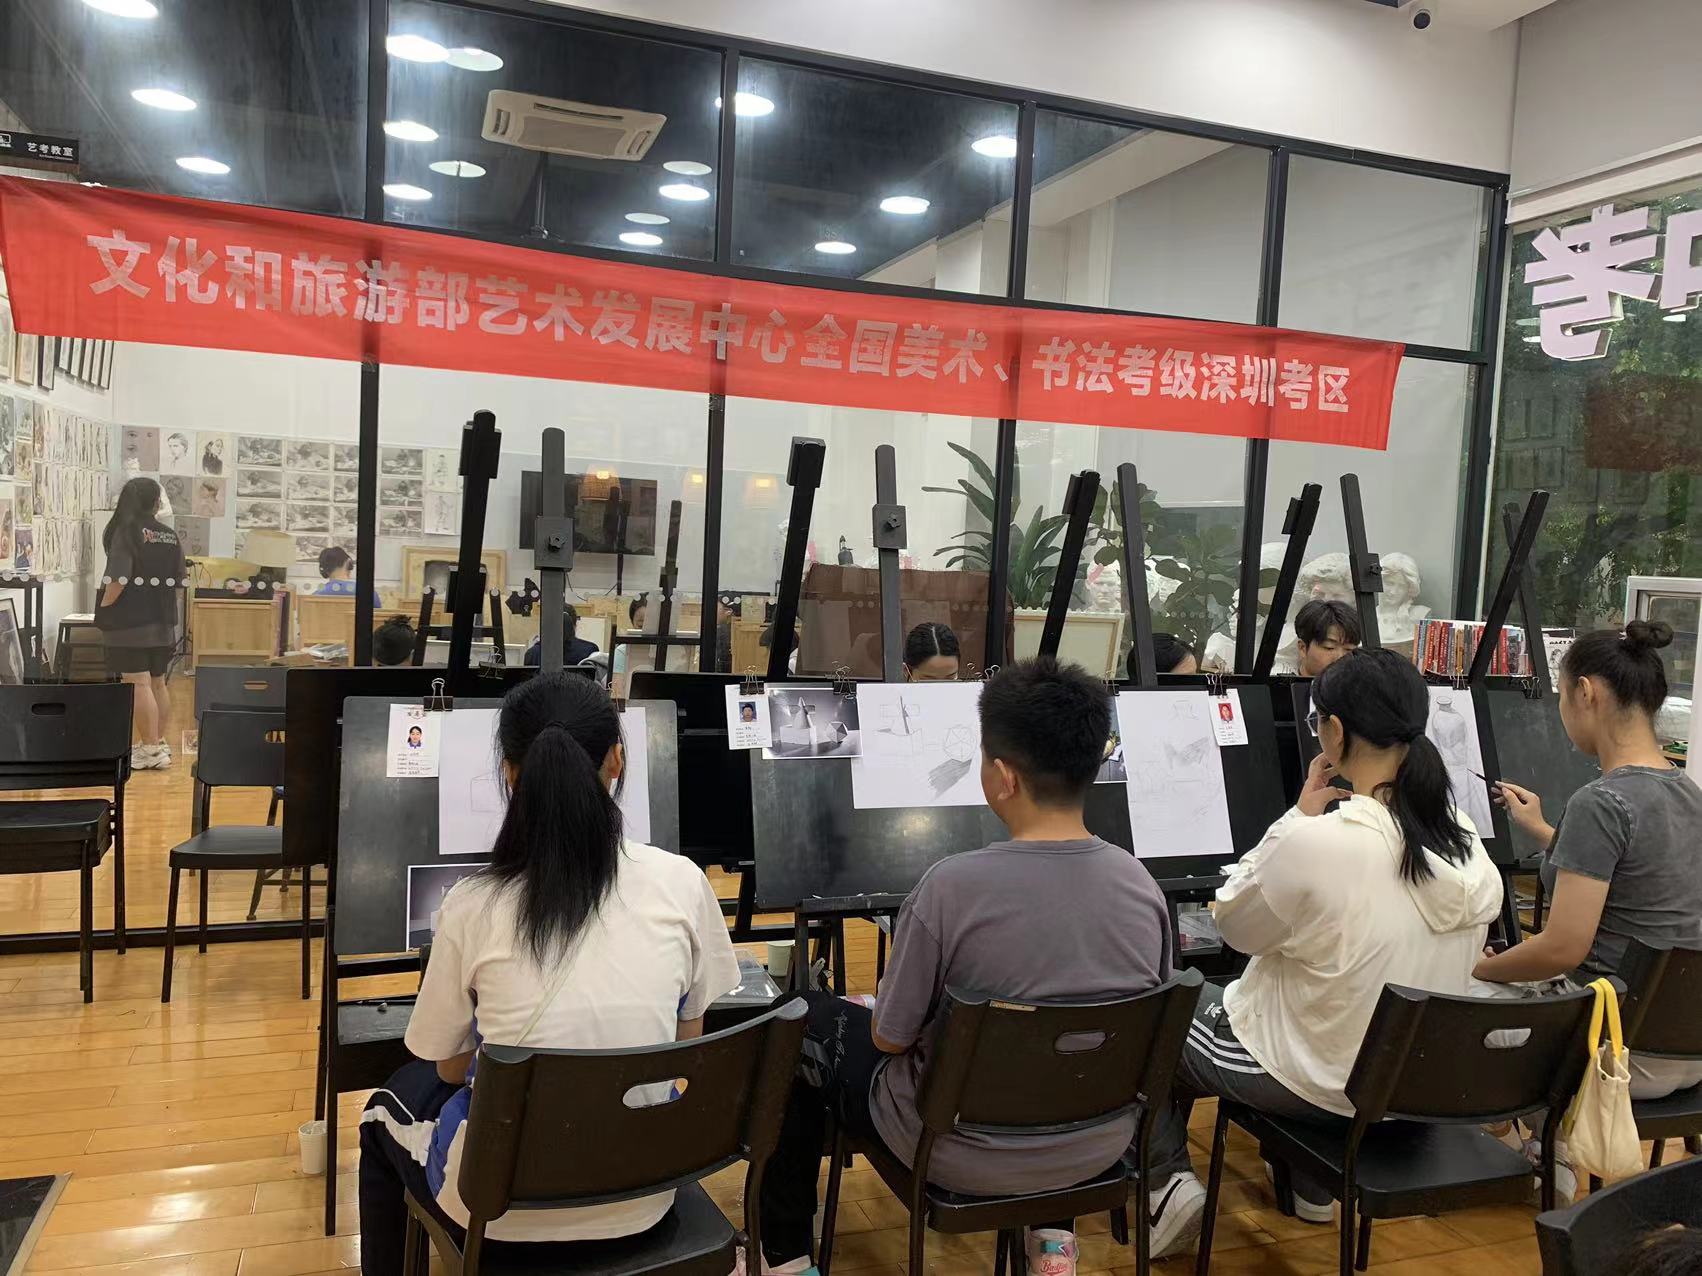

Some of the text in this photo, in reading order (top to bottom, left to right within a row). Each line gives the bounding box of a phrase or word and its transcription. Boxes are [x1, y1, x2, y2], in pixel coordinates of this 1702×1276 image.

[27, 142, 74, 157] 艺考教室
[86, 228, 1351, 414] 文化和旅游部艺术发展中心全国美术、书法考级深圳考区
